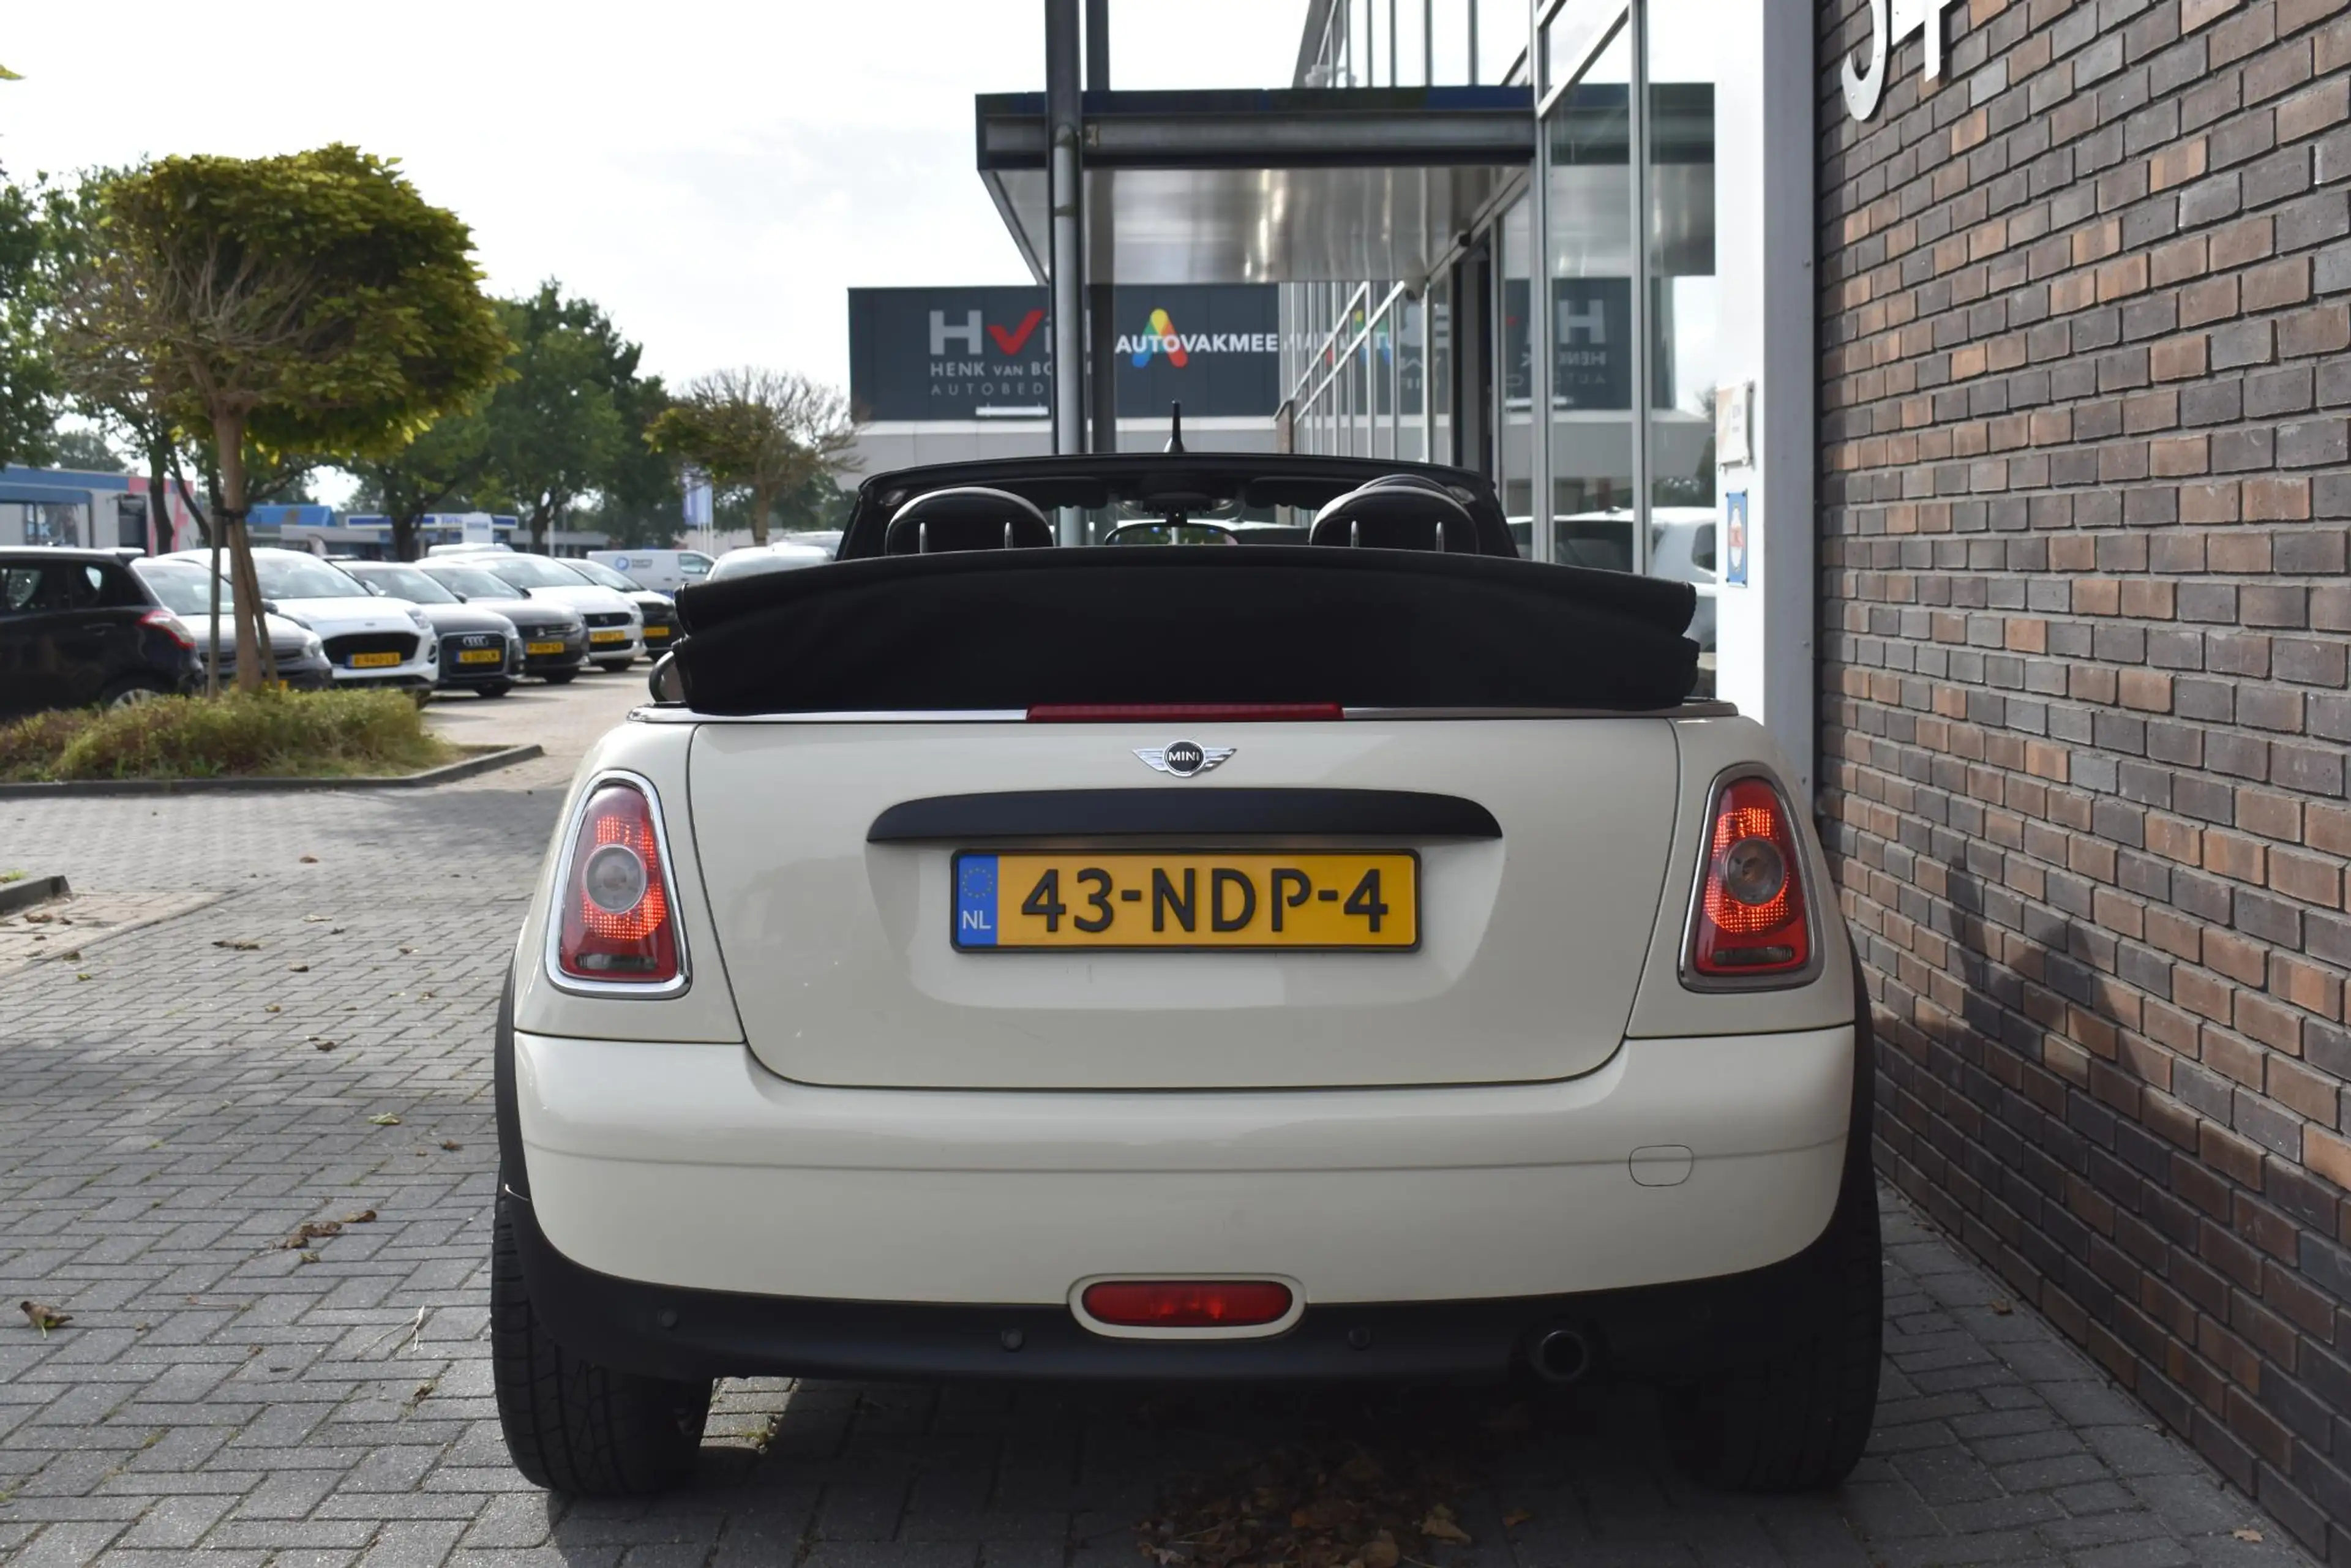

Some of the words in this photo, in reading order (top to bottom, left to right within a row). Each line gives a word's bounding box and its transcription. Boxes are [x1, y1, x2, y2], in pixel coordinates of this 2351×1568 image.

[1115, 334, 1279, 353] AUTOVAKMEE
[930, 362, 985, 377] HENK
[993, 365, 1024, 376] VAN
[931, 382, 1044, 396] AUTOBED
[1168, 751, 1199, 762] MINI
[1021, 868, 1389, 933] 43-NDP-4
[962, 910, 991, 929] NL
